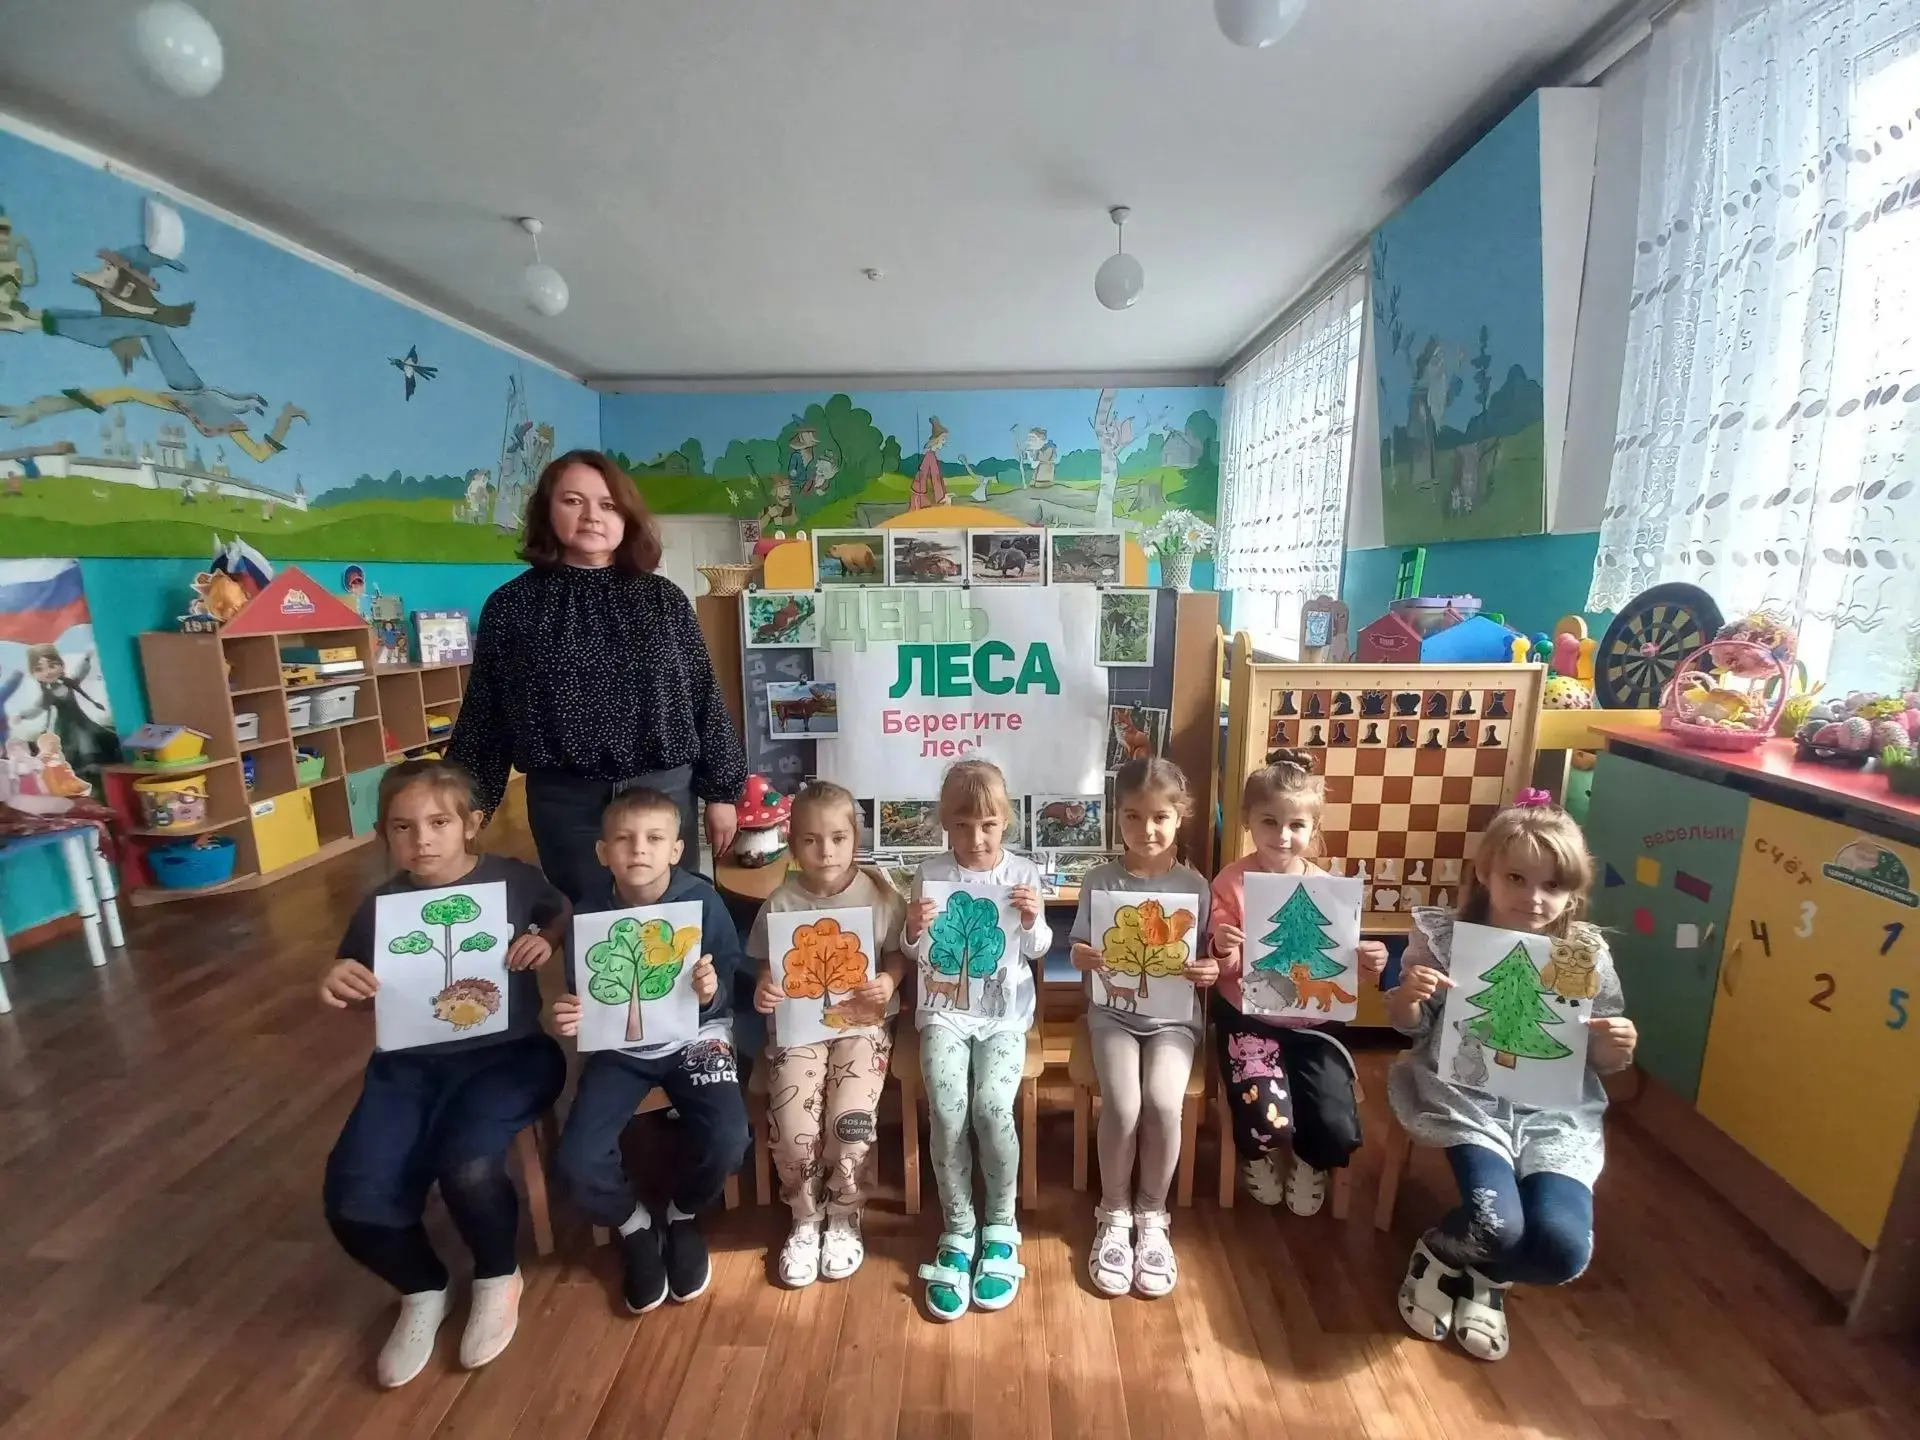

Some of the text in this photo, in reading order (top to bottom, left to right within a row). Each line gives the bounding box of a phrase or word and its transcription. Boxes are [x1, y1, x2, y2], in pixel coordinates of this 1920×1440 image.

[820, 590, 990, 652] ДЕНЬ
[889, 640, 1061, 698] ЛЕСА
[882, 708, 1022, 738] Берегите
[1755, 838, 1812, 885] счёт
[1751, 919, 1771, 957] 4
[1794, 901, 1818, 937] 3
[1880, 922, 1904, 956] 1
[1809, 973, 1836, 1012] 2
[1886, 988, 1909, 1030] 5
